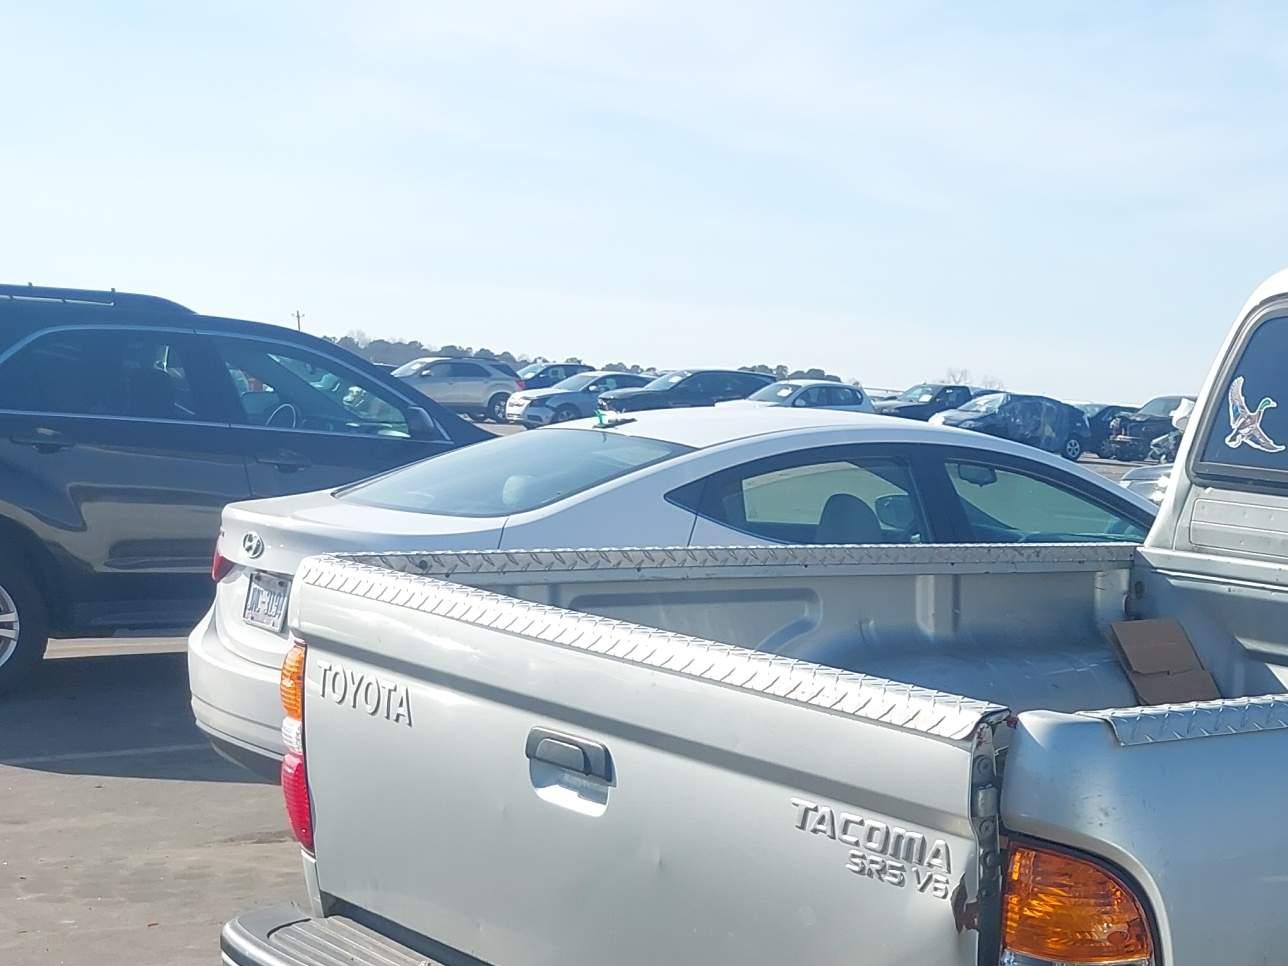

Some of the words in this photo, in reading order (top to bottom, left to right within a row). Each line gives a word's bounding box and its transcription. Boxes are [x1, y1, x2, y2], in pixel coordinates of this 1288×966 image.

[316, 659, 413, 728] TOYOTA
[791, 797, 952, 874] TACOMA
[846, 848, 907, 888] SR5
[912, 867, 951, 900] V6
